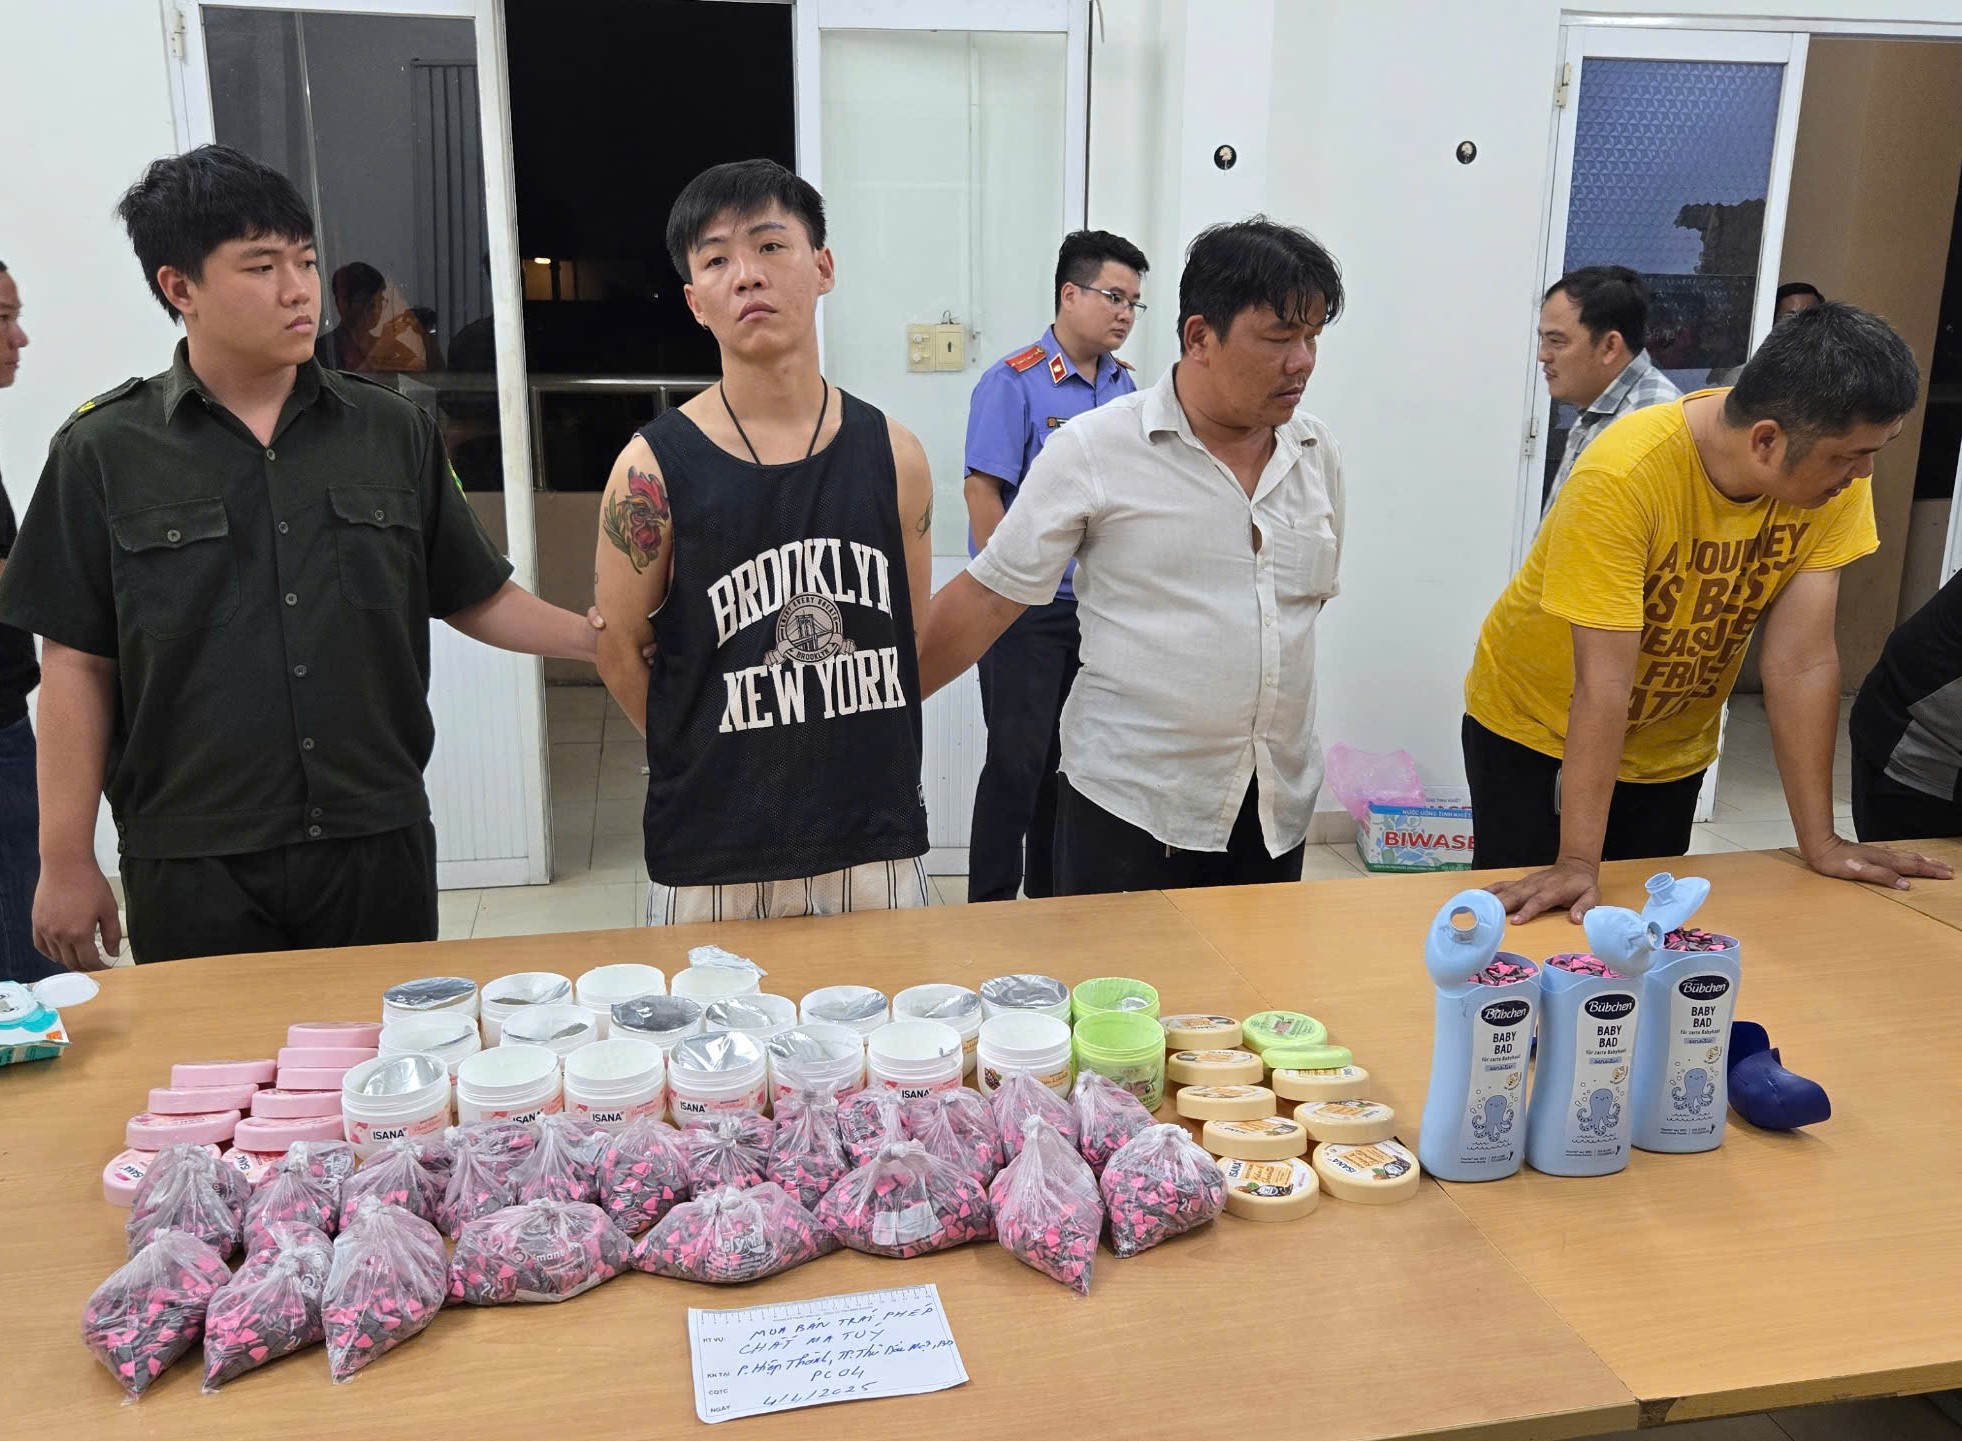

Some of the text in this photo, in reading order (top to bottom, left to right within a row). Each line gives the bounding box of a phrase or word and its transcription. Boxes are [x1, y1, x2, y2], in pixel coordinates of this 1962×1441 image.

[1656, 541, 1679, 573] A
[706, 538, 893, 649] BROOKLYN
[796, 648, 830, 661] BROOKLYN
[718, 646, 906, 733] NEW YORK
[1682, 982, 1726, 993] Bübchen
[1588, 1001, 1633, 1012] Bübchen
[1691, 1006, 1716, 1016] BABY
[1485, 1007, 1527, 1020] Bübchen
[1693, 1018, 1712, 1028] BAD
[1597, 1025, 1622, 1036] BABY
[1493, 1031, 1517, 1043] BABY
[1599, 1038, 1618, 1048] BAD
[1494, 1043, 1513, 1055] BAD
[901, 1089, 930, 1099] ISANA
[680, 1101, 706, 1113] ISANA
[592, 1113, 622, 1122] ISANA
[373, 1129, 405, 1140] ISANA
[750, 1326, 787, 1341] MUA
[806, 1335, 833, 1345] MA
